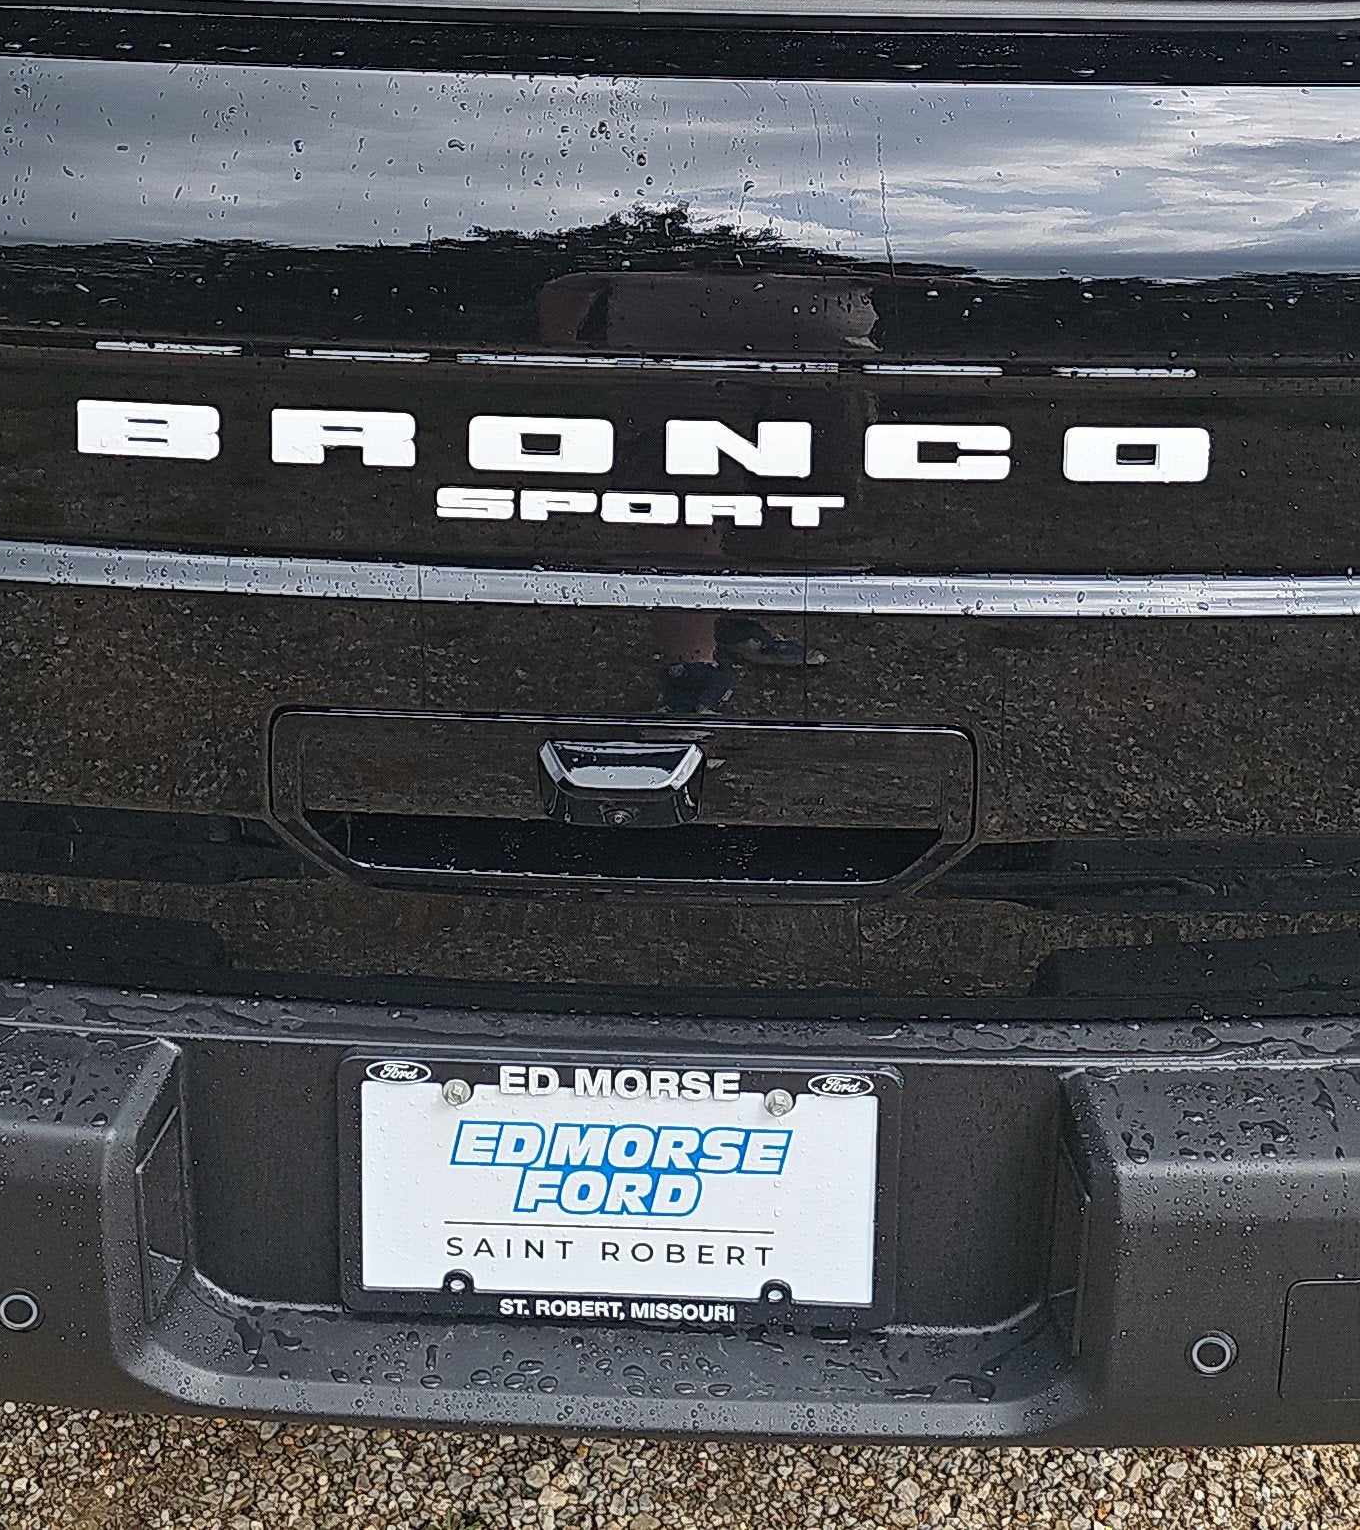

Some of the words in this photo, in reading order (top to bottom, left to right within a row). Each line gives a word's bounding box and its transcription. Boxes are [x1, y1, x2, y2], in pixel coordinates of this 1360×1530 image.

[76, 399, 1210, 485] BRONCO
[436, 487, 845, 528] SPORT
[380, 1063, 418, 1080] Ford
[499, 1065, 559, 1096] ED
[574, 1067, 741, 1102] MORSE
[821, 1076, 861, 1093] Ford
[450, 1120, 546, 1166] ED
[543, 1122, 793, 1175] MORSE
[513, 1170, 702, 1217] FORD
[445, 1236, 574, 1261] SAINT
[601, 1242, 774, 1267] ROBERT
[499, 1298, 530, 1316] ST.
[535, 1300, 626, 1321] ROBERT,
[630, 1302, 736, 1322] MISSOURI
